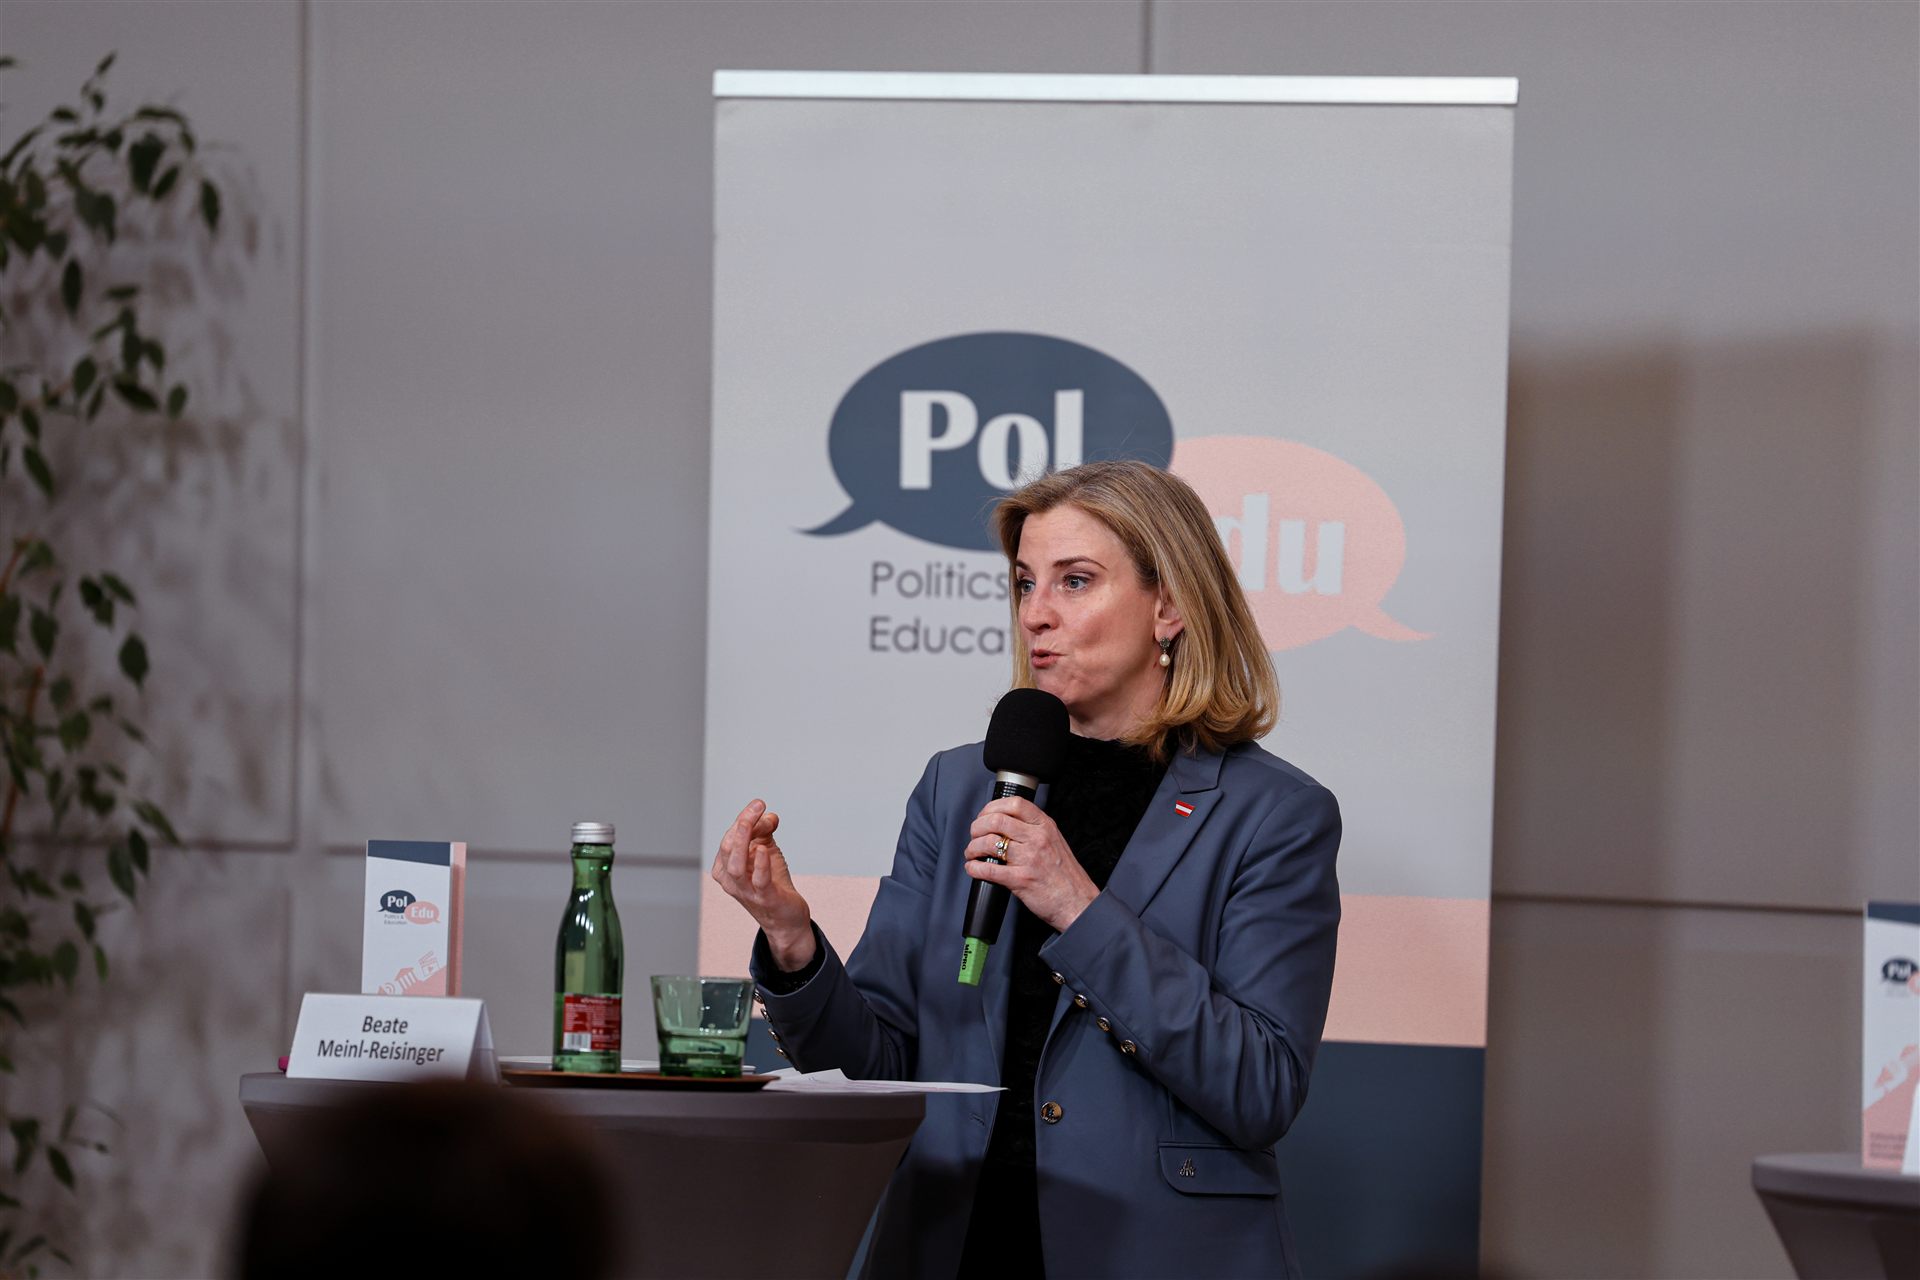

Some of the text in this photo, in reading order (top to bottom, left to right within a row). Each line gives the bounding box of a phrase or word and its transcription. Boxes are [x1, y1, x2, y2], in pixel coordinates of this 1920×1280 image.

[900, 388, 1084, 490] Pol
[1214, 491, 1344, 595] du
[871, 560, 1009, 601] Politics
[869, 615, 1006, 655] Educa
[387, 895, 408, 908] Pol
[411, 907, 434, 919] Edu
[362, 1015, 409, 1034] Beate
[317, 1039, 445, 1066] Meinl-Reisinger
